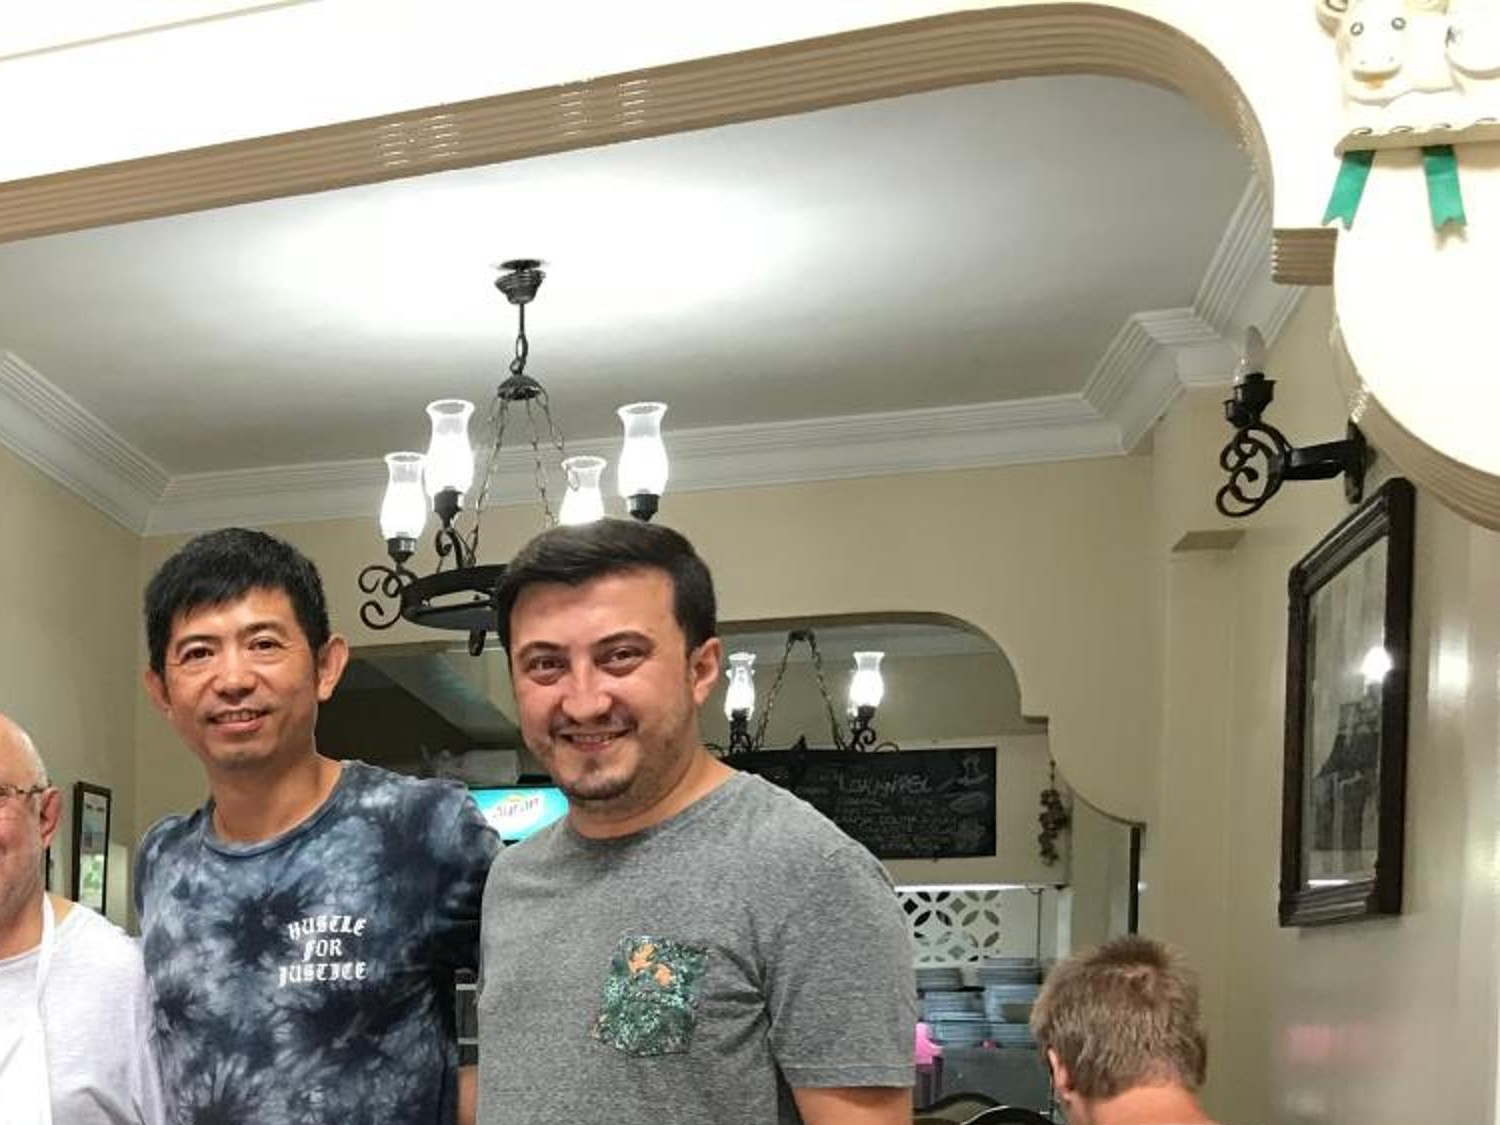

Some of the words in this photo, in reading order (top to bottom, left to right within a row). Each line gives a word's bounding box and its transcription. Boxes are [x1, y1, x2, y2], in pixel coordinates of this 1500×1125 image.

[288, 915, 367, 941] HUSTLE
[302, 939, 343, 962] FOR
[278, 961, 367, 988] JUSTICE
